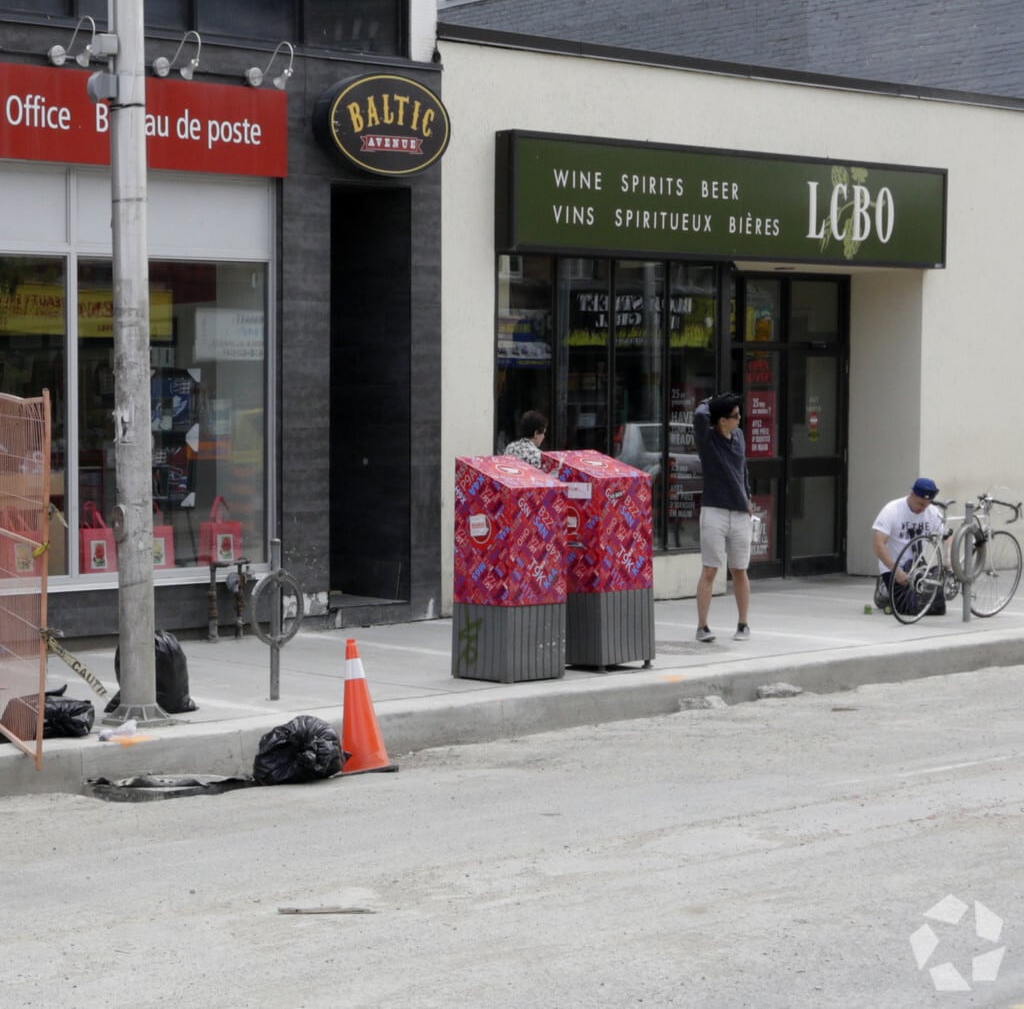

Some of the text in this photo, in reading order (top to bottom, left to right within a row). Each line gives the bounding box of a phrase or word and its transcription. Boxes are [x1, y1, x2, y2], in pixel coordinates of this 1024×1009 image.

[5, 94, 71, 130] Office
[176, 109, 201, 140] de
[207, 118, 262, 149] poste
[346, 93, 435, 137] BALTIC
[368, 137, 417, 149] AVENUE
[553, 169, 739, 201] WINE SPIRITS BEER
[552, 205, 780, 237] VINS SPIRITUEUX BIÈRES
[806, 180, 895, 244] LCBO
